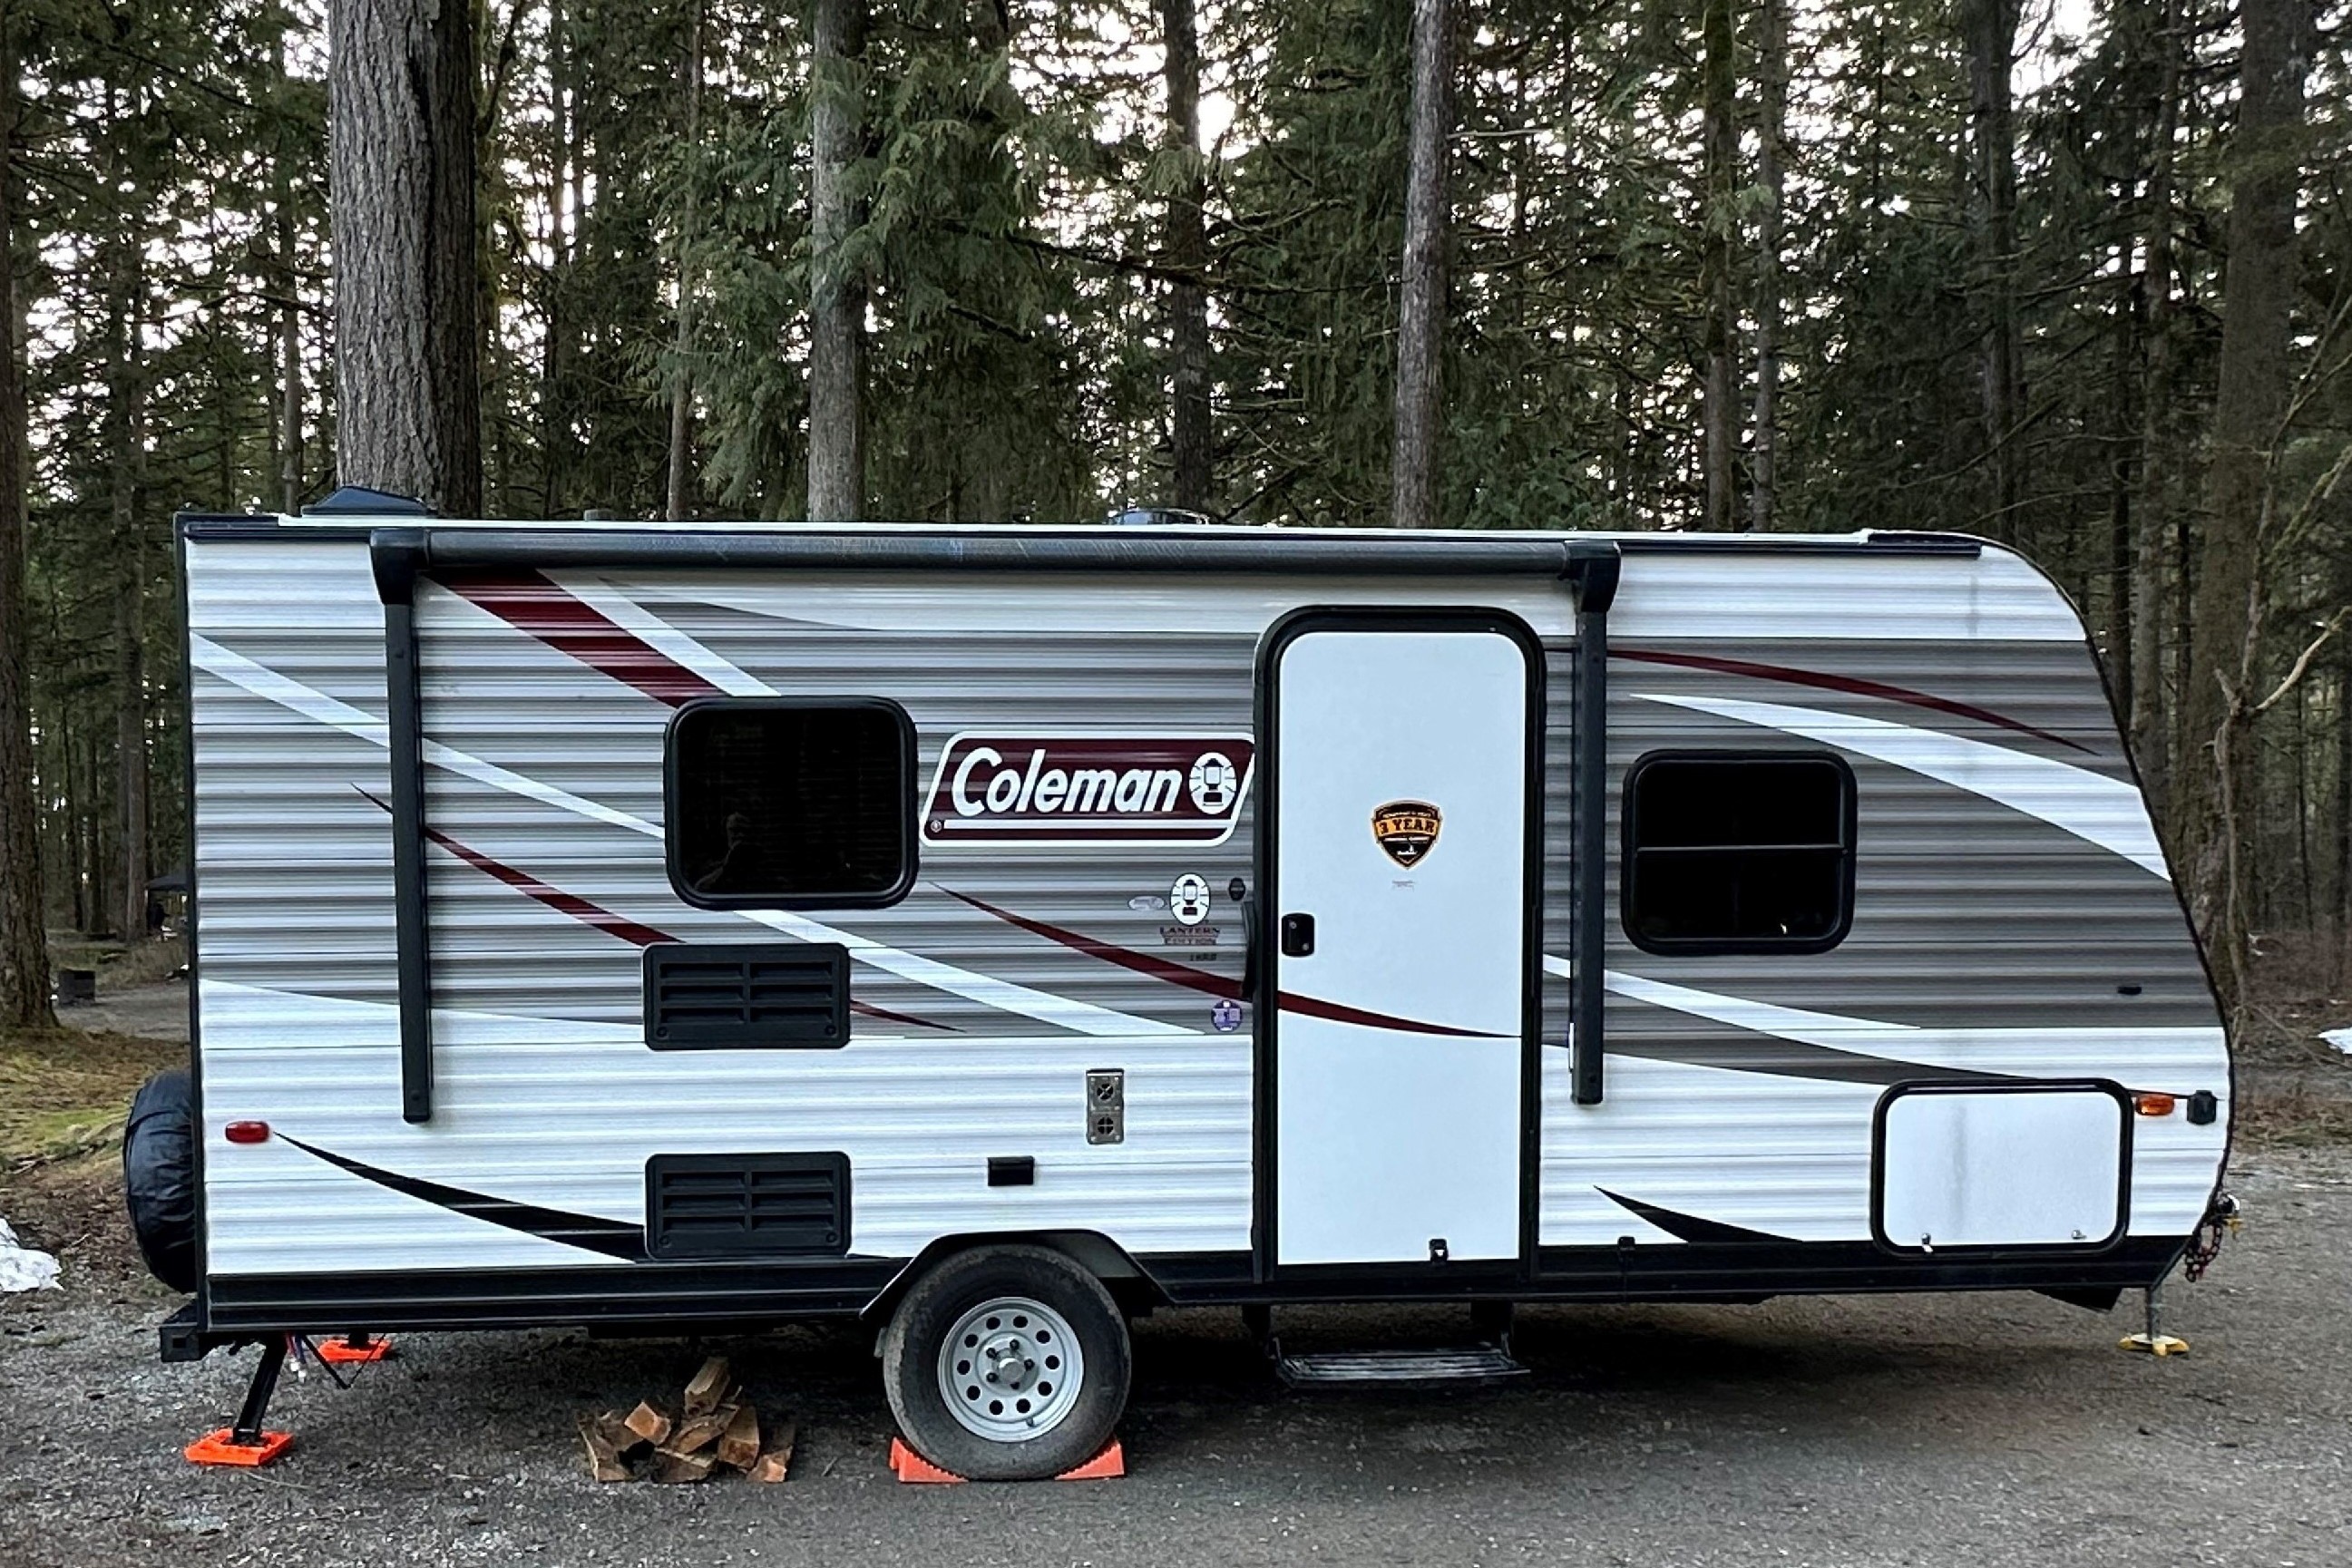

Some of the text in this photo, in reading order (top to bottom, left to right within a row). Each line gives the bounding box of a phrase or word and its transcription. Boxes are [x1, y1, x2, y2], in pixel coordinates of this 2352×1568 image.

[952, 746, 1183, 817] Coleman
[1379, 818, 1435, 833] 3 YEAR
[1160, 927, 1220, 936] LANTERN
